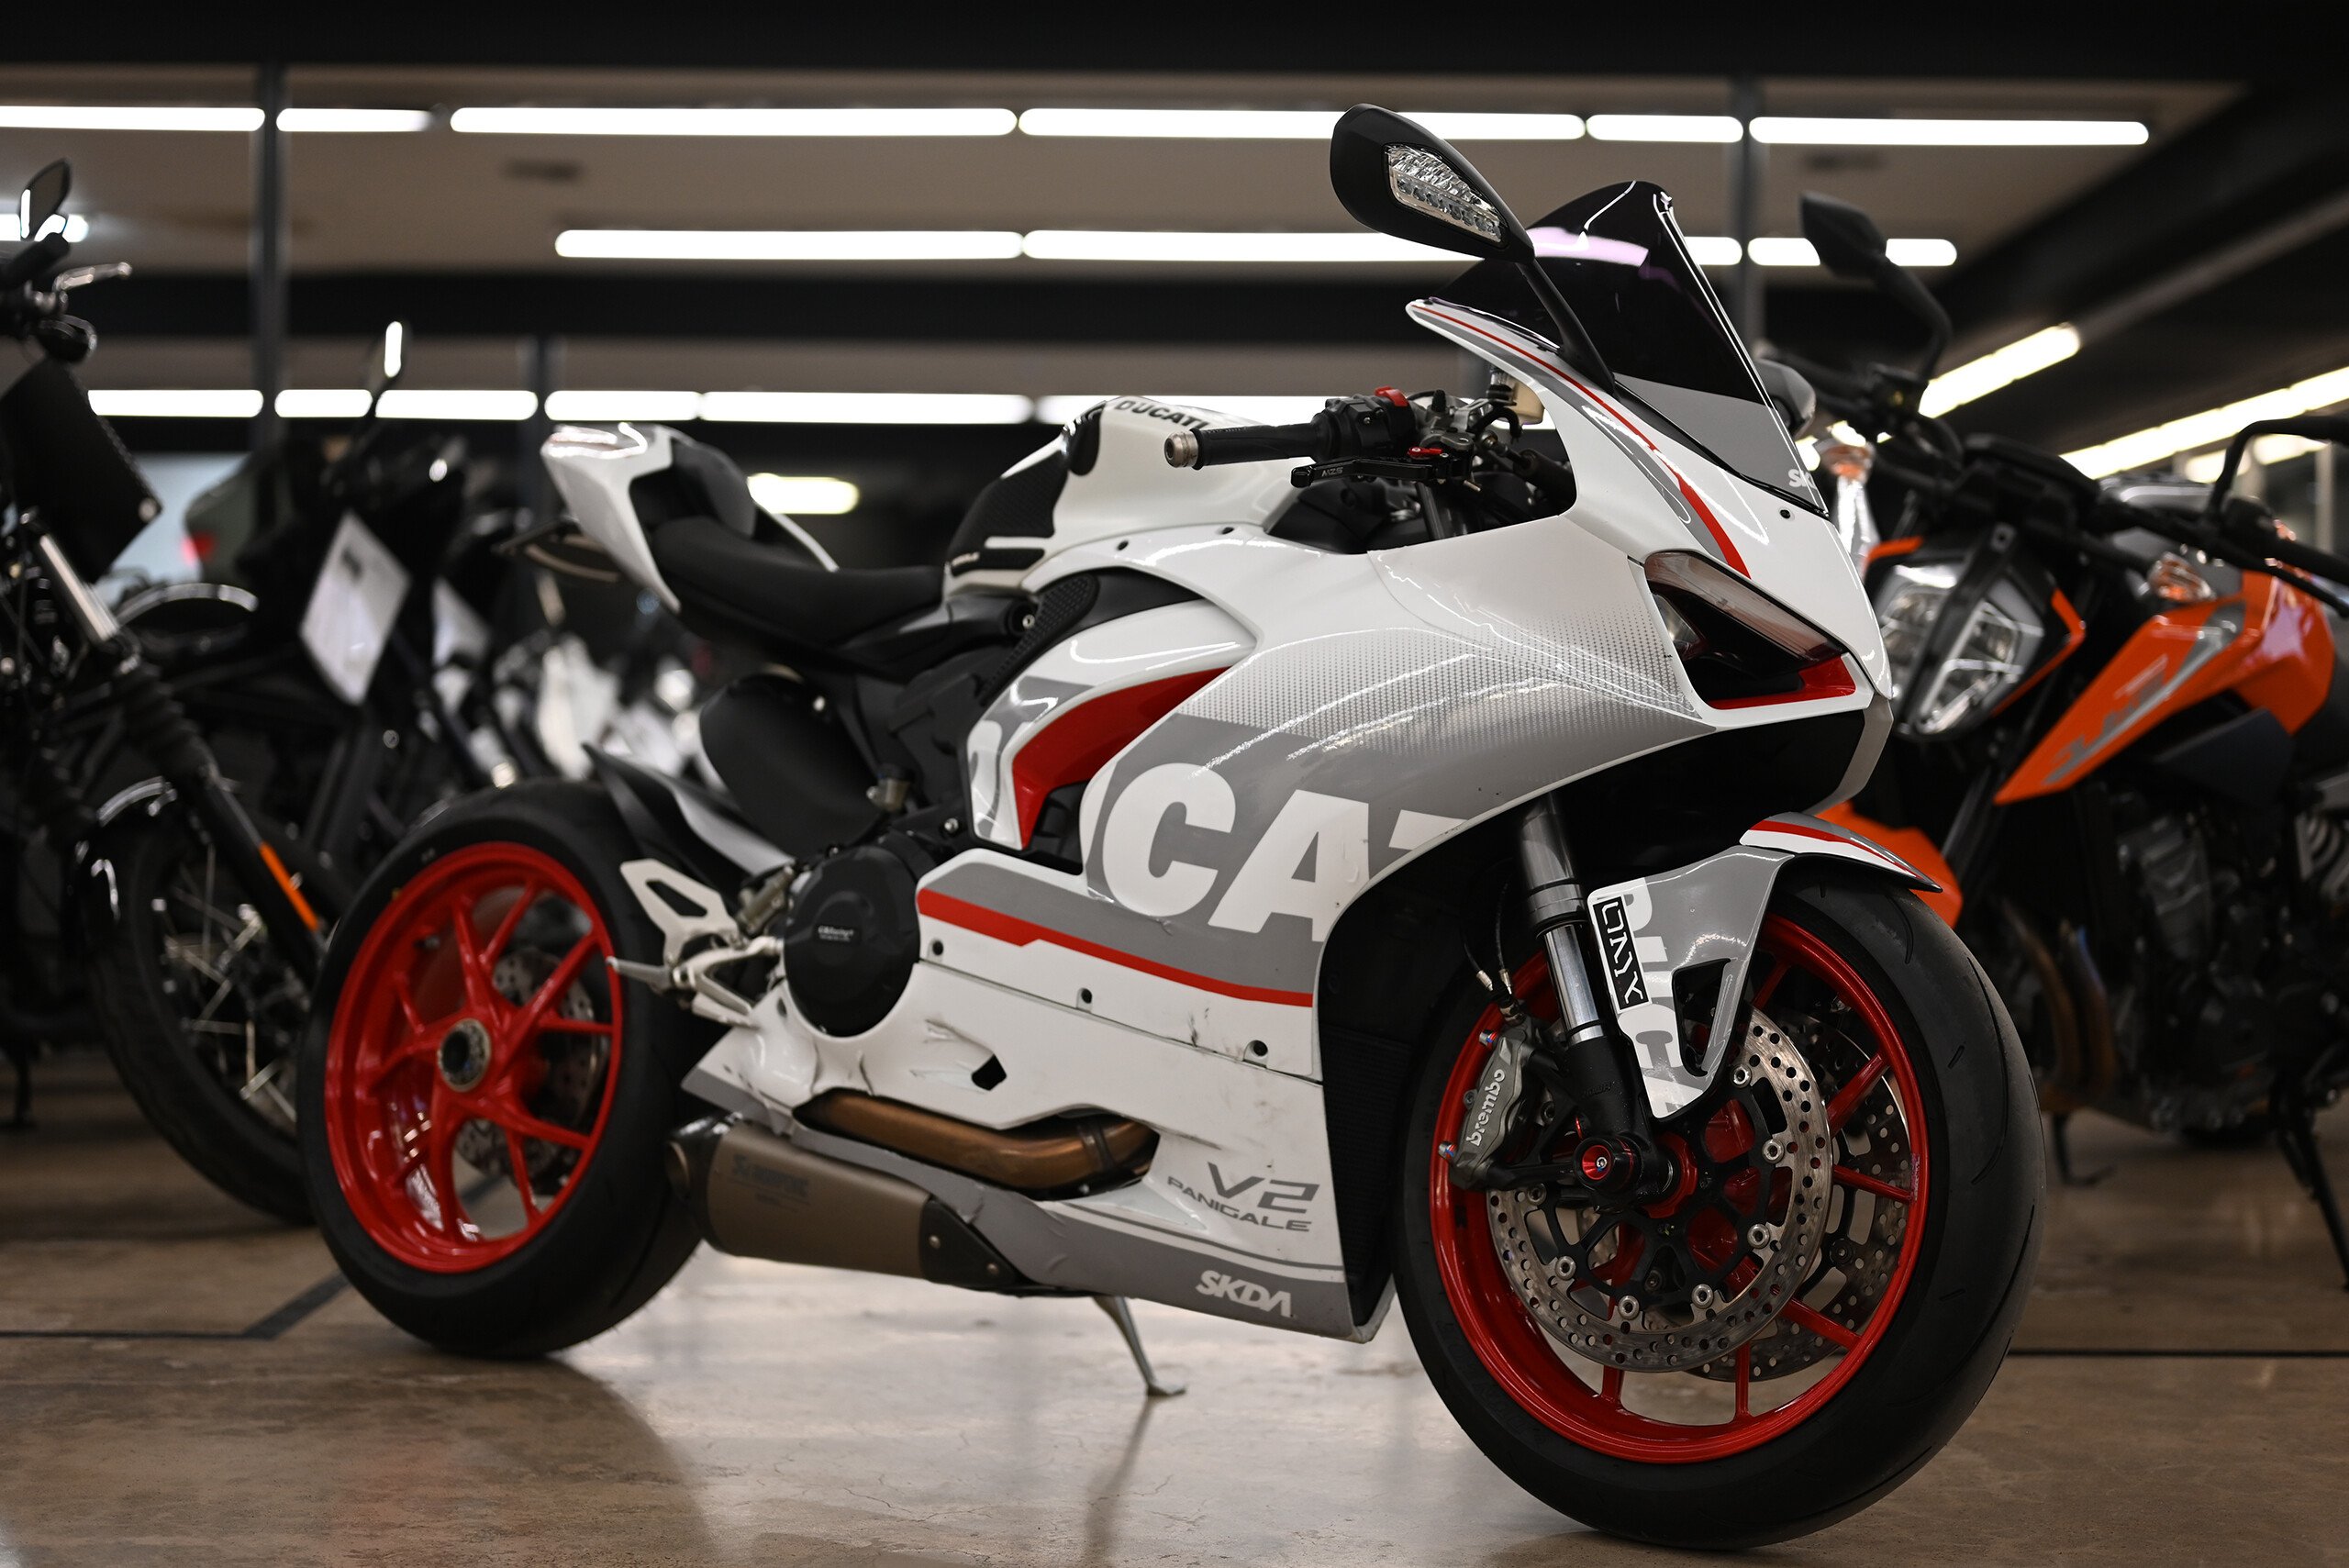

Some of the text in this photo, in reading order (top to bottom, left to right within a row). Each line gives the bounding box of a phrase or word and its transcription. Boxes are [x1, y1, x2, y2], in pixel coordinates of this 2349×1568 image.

[1601, 901, 1643, 1005] ONYX
[1465, 1069, 1506, 1147] brembo
[1167, 1176, 1312, 1232] PANIGALE
[1207, 1162, 1320, 1214] V2
[1195, 1270, 1292, 1318] SKDA
